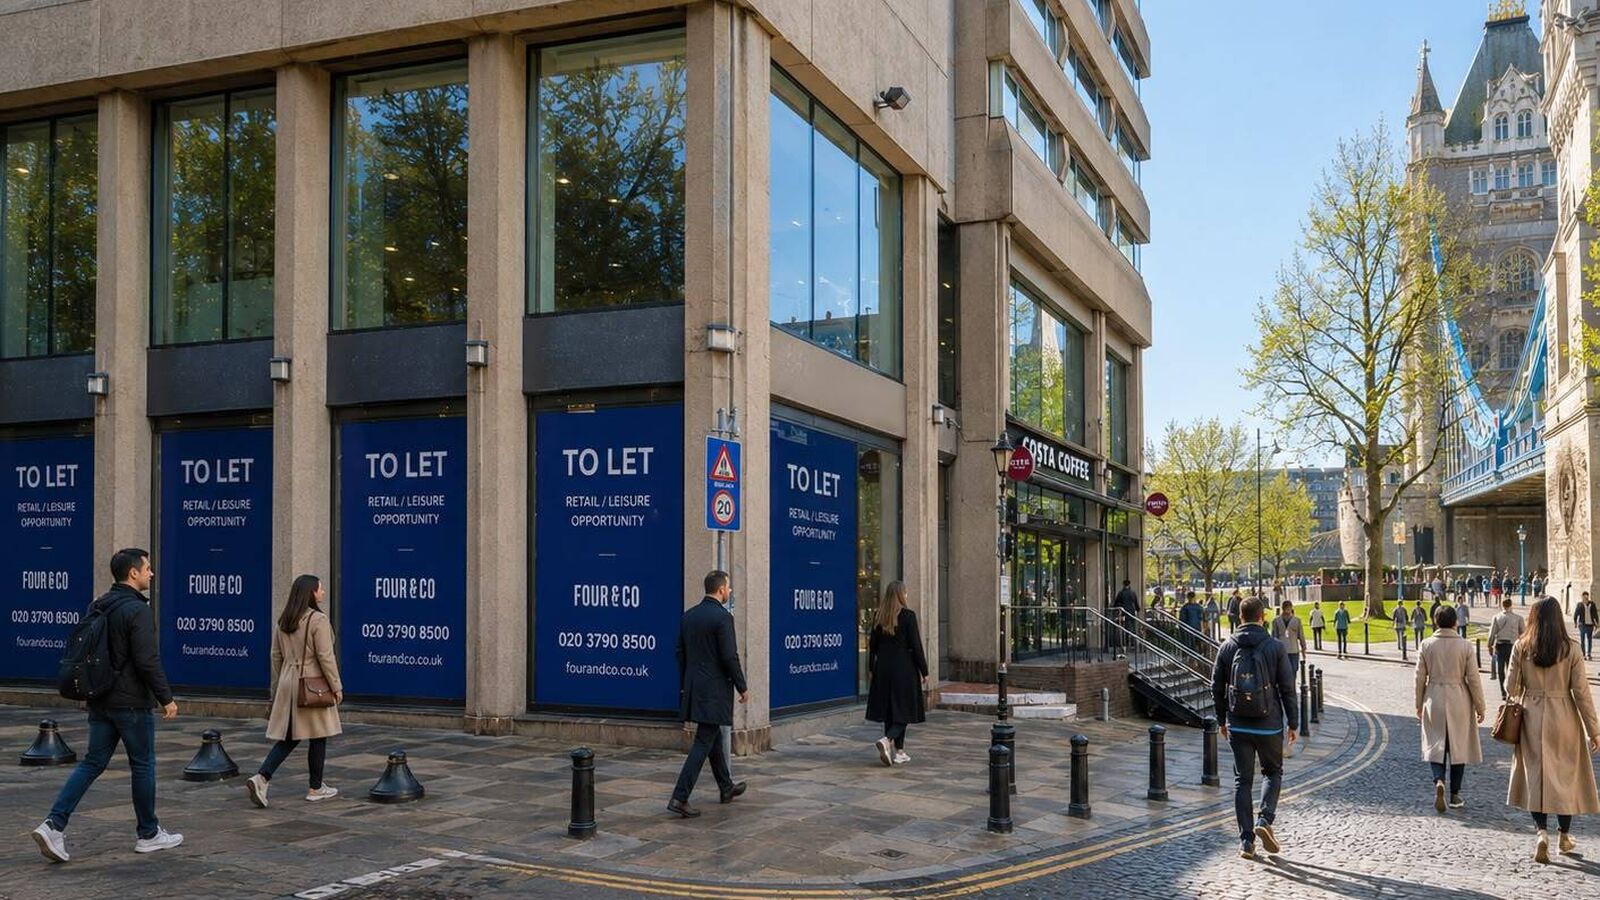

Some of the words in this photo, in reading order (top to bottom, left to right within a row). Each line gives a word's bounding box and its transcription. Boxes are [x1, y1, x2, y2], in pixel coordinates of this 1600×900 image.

[366, 453, 398, 478] TO
[406, 451, 447, 477] LET
[563, 448, 598, 476] TO
[608, 447, 653, 475] LET
[1058, 451, 1089, 481] COFFEE
[16, 466, 40, 488] TO
[46, 465, 78, 487] LET
[181, 460, 210, 483] TO
[217, 458, 254, 482] LET
[787, 464, 809, 491] TO
[815, 470, 840, 497] LET
[183, 500, 210, 510] RETAIL
[212, 500, 216, 510] /
[217, 499, 251, 510] LEISURE
[368, 496, 399, 507] RETAIL
[401, 496, 405, 507] /
[407, 495, 444, 506] LEISURE
[566, 496, 598, 507] RETAIL
[601, 496, 606, 508] /
[609, 495, 650, 507] LEISURE
[717, 500, 731, 515] 20
[187, 516, 246, 526] OPPORTUNITY
[373, 514, 439, 524] OPPORTUNITY
[571, 515, 644, 526] OPPORTUNITY
[12, 610, 29, 623] 020
[31, 611, 53, 623] 3790
[56, 611, 79, 624] 8500
[177, 617, 196, 630] 020
[199, 618, 224, 631] 3790
[227, 619, 254, 632] 8500
[362, 624, 383, 638] 020
[387, 624, 416, 639] 3790
[419, 626, 449, 640] 8500
[559, 632, 582, 647] 020
[587, 633, 618, 648] 3790
[622, 634, 655, 650] 8500
[785, 635, 801, 649] 020
[803, 635, 822, 648] 3790
[823, 634, 843, 648] 8500
[183, 644, 248, 657] fourandco.co.uk
[368, 652, 442, 665] fourandco.co.uk
[566, 662, 648, 676] fourandco.co.uk
